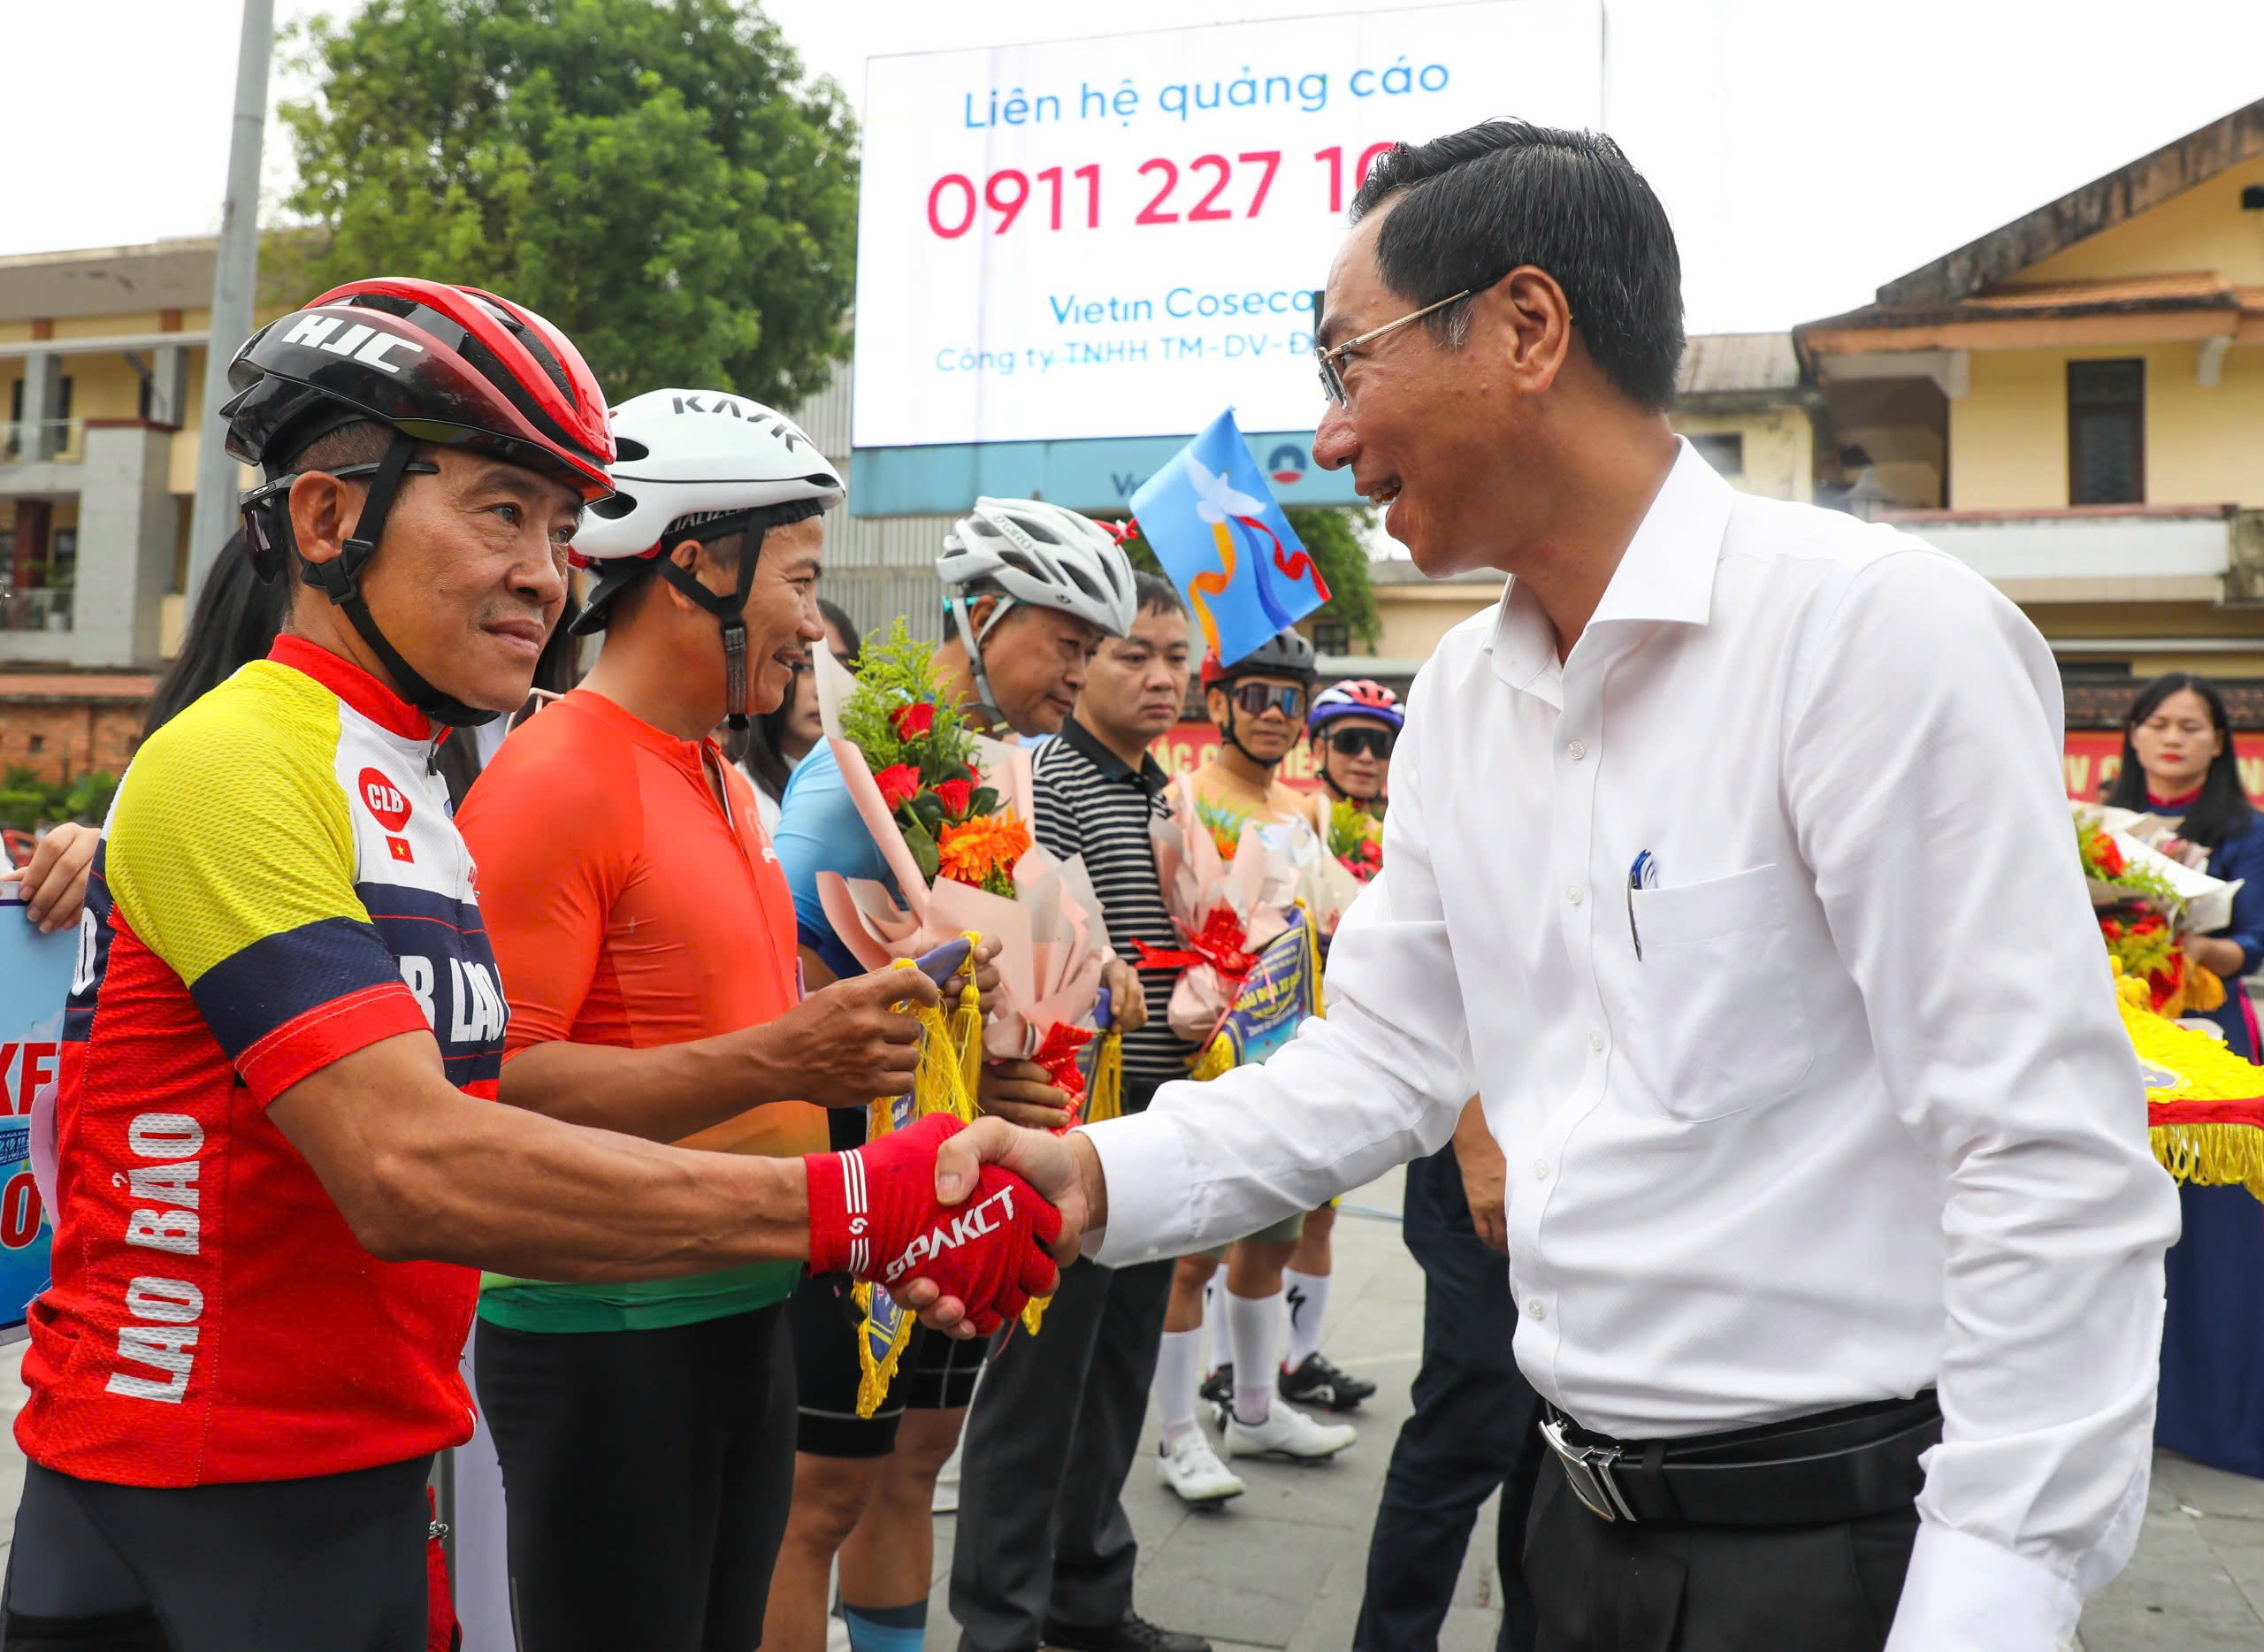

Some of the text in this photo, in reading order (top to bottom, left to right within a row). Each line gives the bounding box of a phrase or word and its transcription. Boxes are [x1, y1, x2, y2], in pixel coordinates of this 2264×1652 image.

[966, 57, 1449, 128] Liên hệ quảng cáo
[928, 164, 1099, 239] 0911
[1136, 151, 1281, 225] 227
[282, 314, 424, 373] HJC
[936, 347, 1015, 375] Công
[1026, 348, 1054, 373] ty
[1066, 340, 1149, 363] TNHH
[672, 396, 803, 453] KASK
[368, 784, 404, 813] CLB
[105, 1113, 205, 1403] LAO BẢO
[886, 1184, 1016, 1281] SPAKCT
